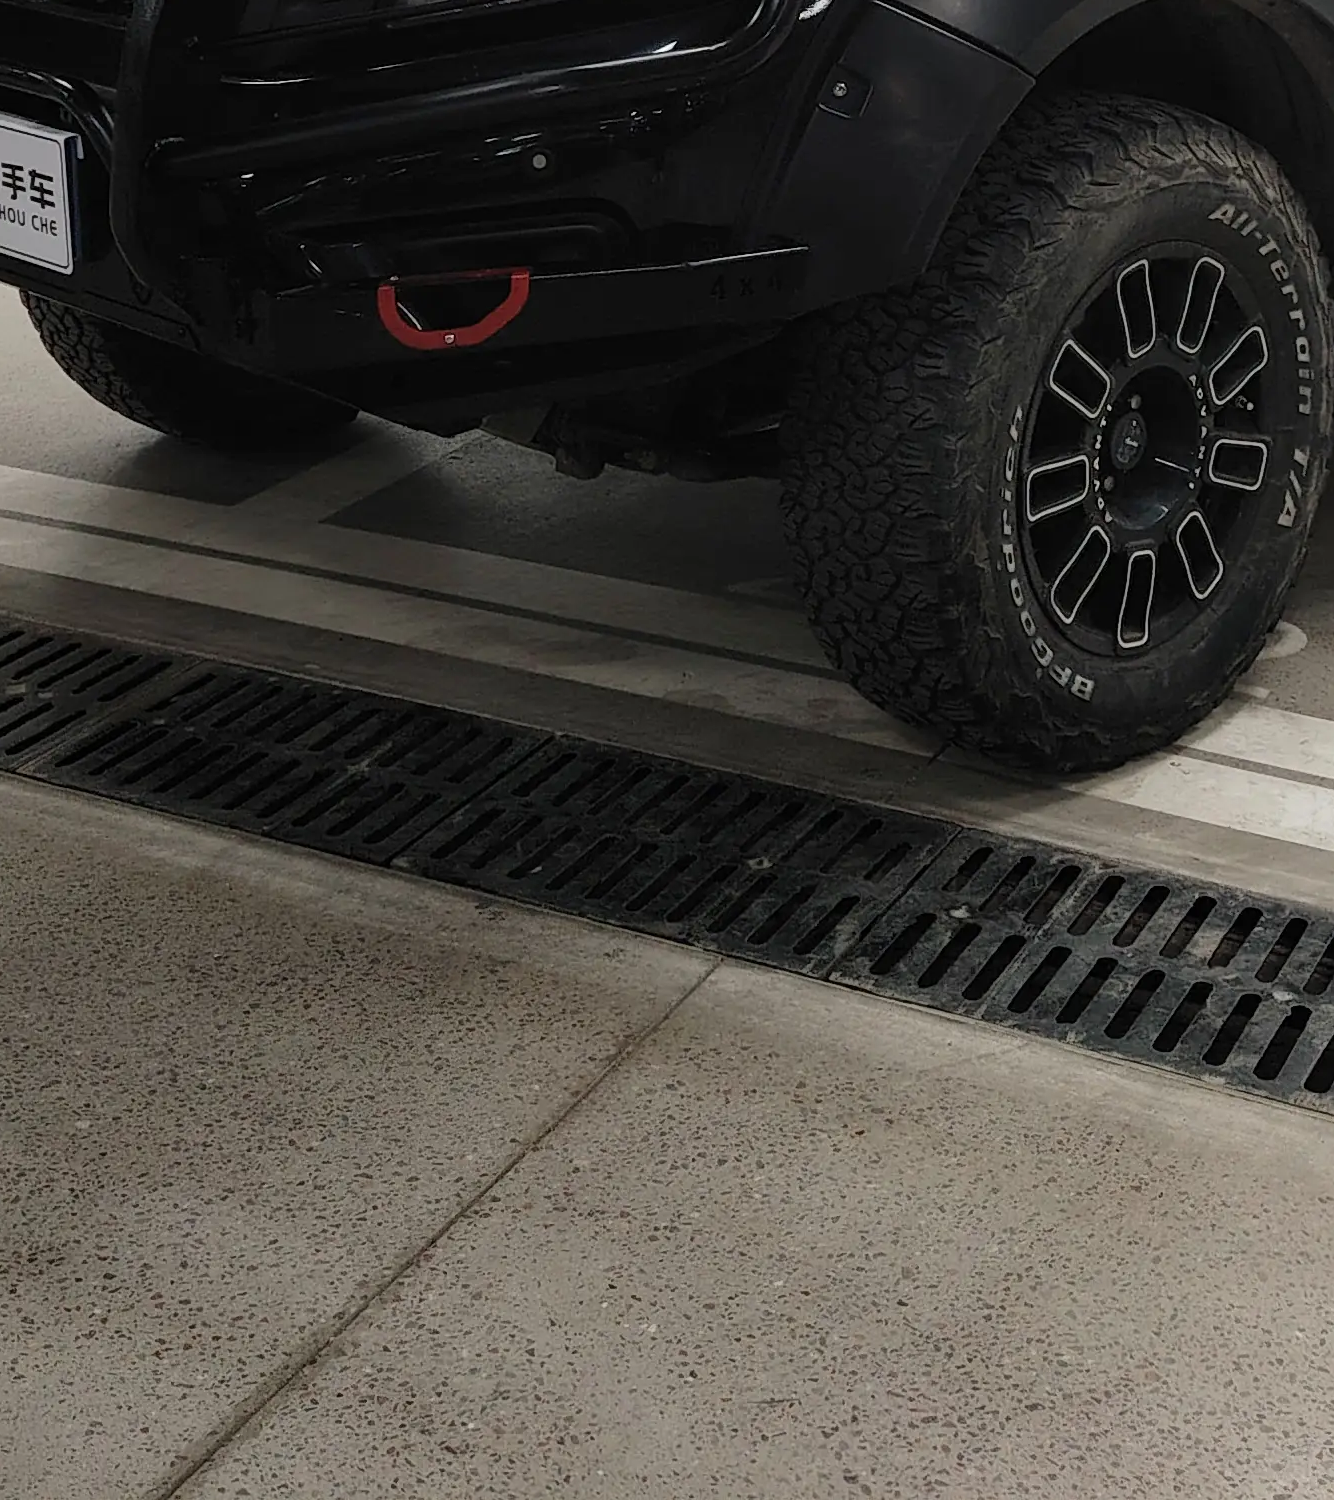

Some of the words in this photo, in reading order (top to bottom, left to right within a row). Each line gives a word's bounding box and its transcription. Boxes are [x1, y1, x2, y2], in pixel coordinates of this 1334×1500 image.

[31, 215, 58, 237] CHE
[1208, 203, 1315, 415] All-Terrain
[1277, 448, 1310, 528] T/A
[1001, 405, 1095, 701] BFGoodrich
